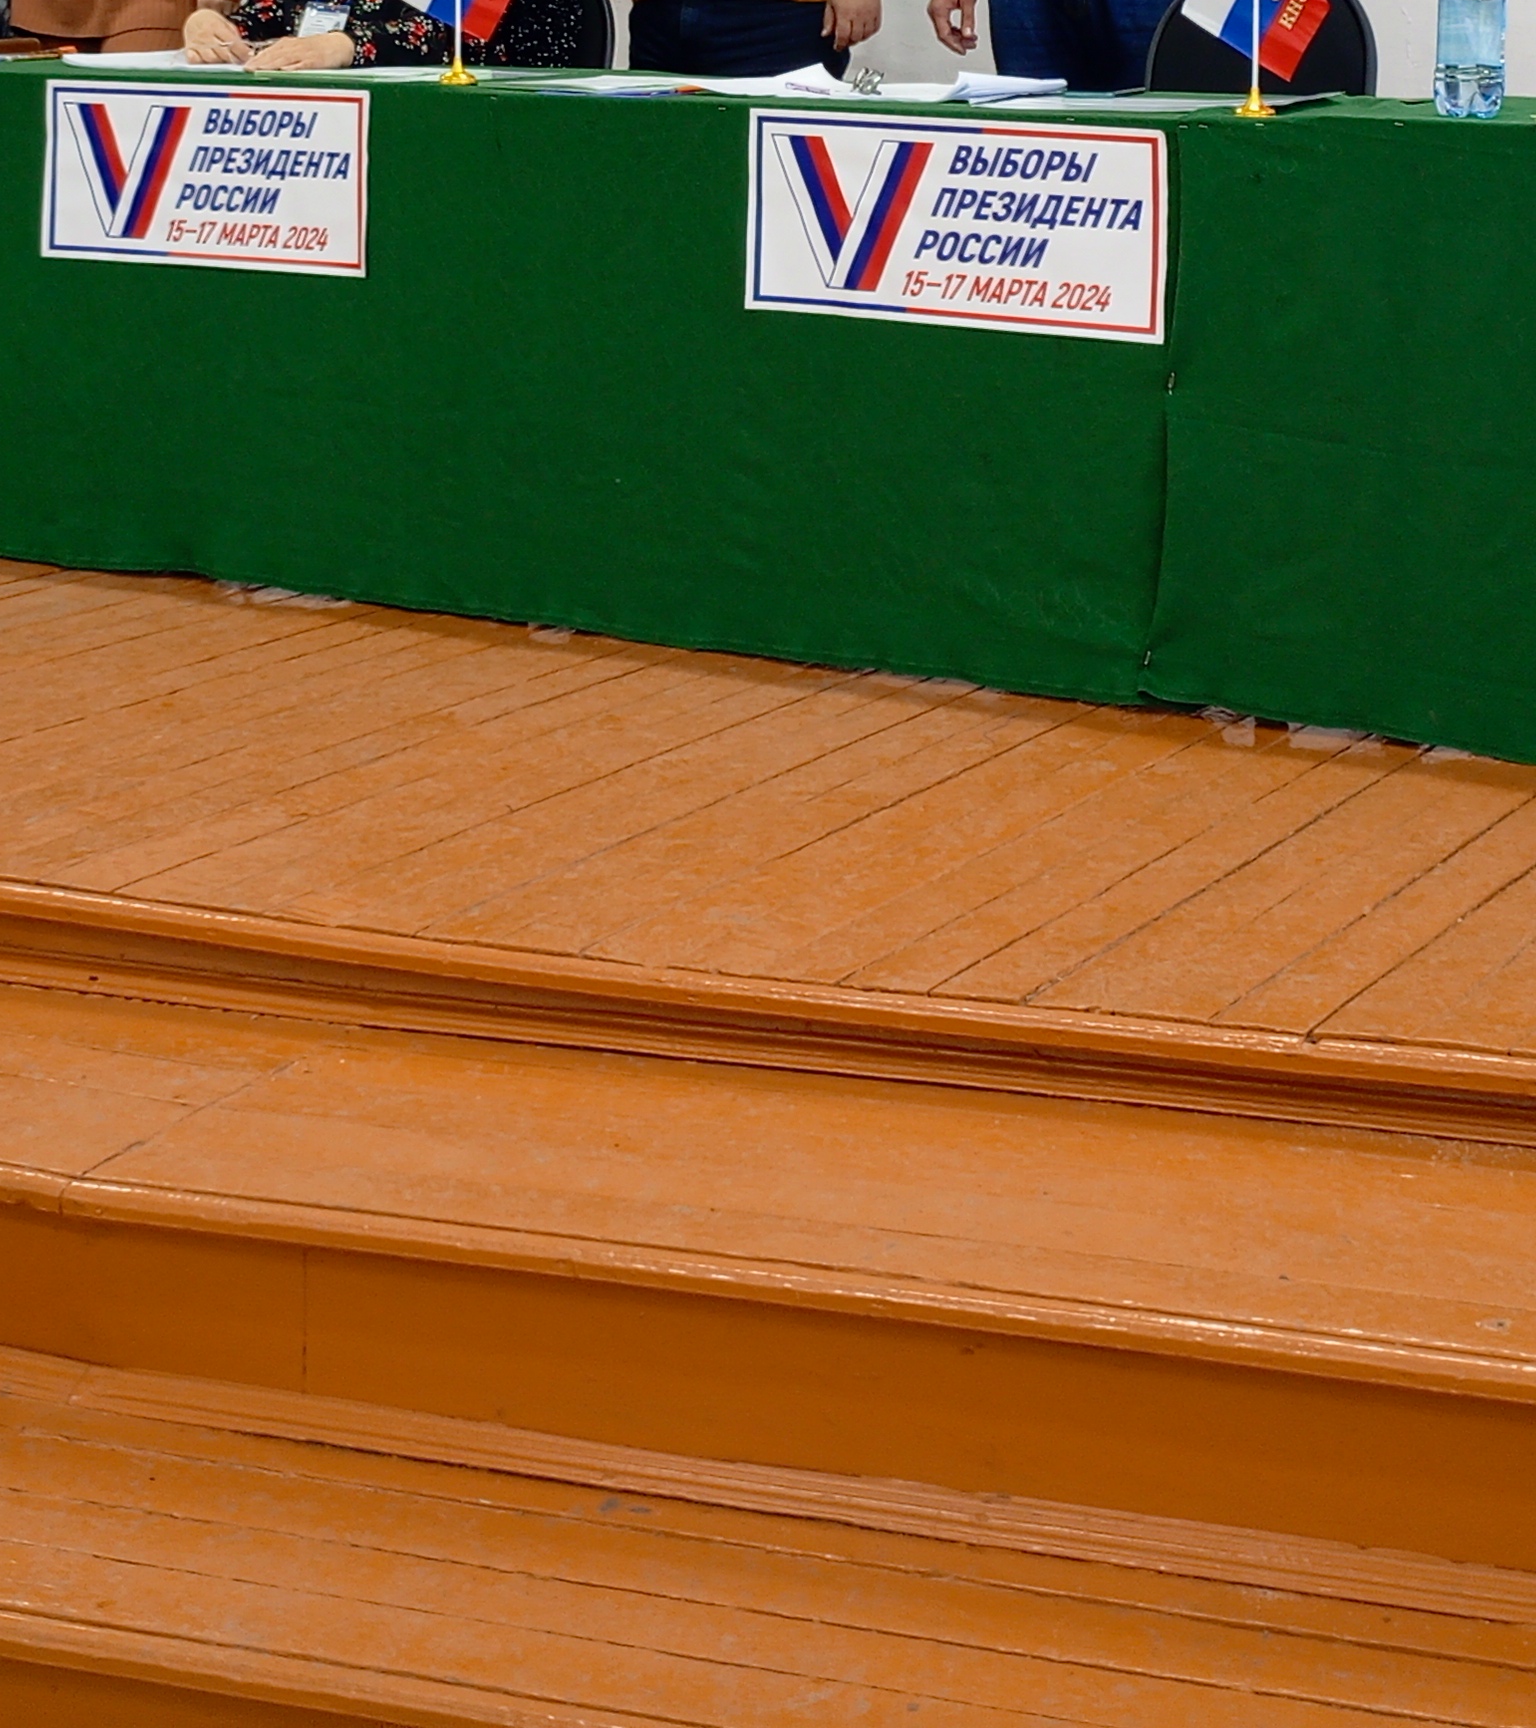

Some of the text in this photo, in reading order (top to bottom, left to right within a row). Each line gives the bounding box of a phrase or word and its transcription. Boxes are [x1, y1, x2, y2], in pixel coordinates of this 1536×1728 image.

[202, 108, 318, 139] ВЫБОРЫ
[188, 145, 351, 181] ПРЕЗИДЕНТА
[947, 144, 1098, 183] ВЫБОРЫ
[175, 183, 281, 215] РОССИИ
[930, 187, 1143, 233] ПРЕЗИДЕНТА
[215, 222, 281, 249] МАРТА
[281, 225, 329, 252] 2024
[913, 229, 1050, 269] РОССИИ
[966, 275, 1049, 308] МАРТА
[1050, 281, 1112, 313] 2024
